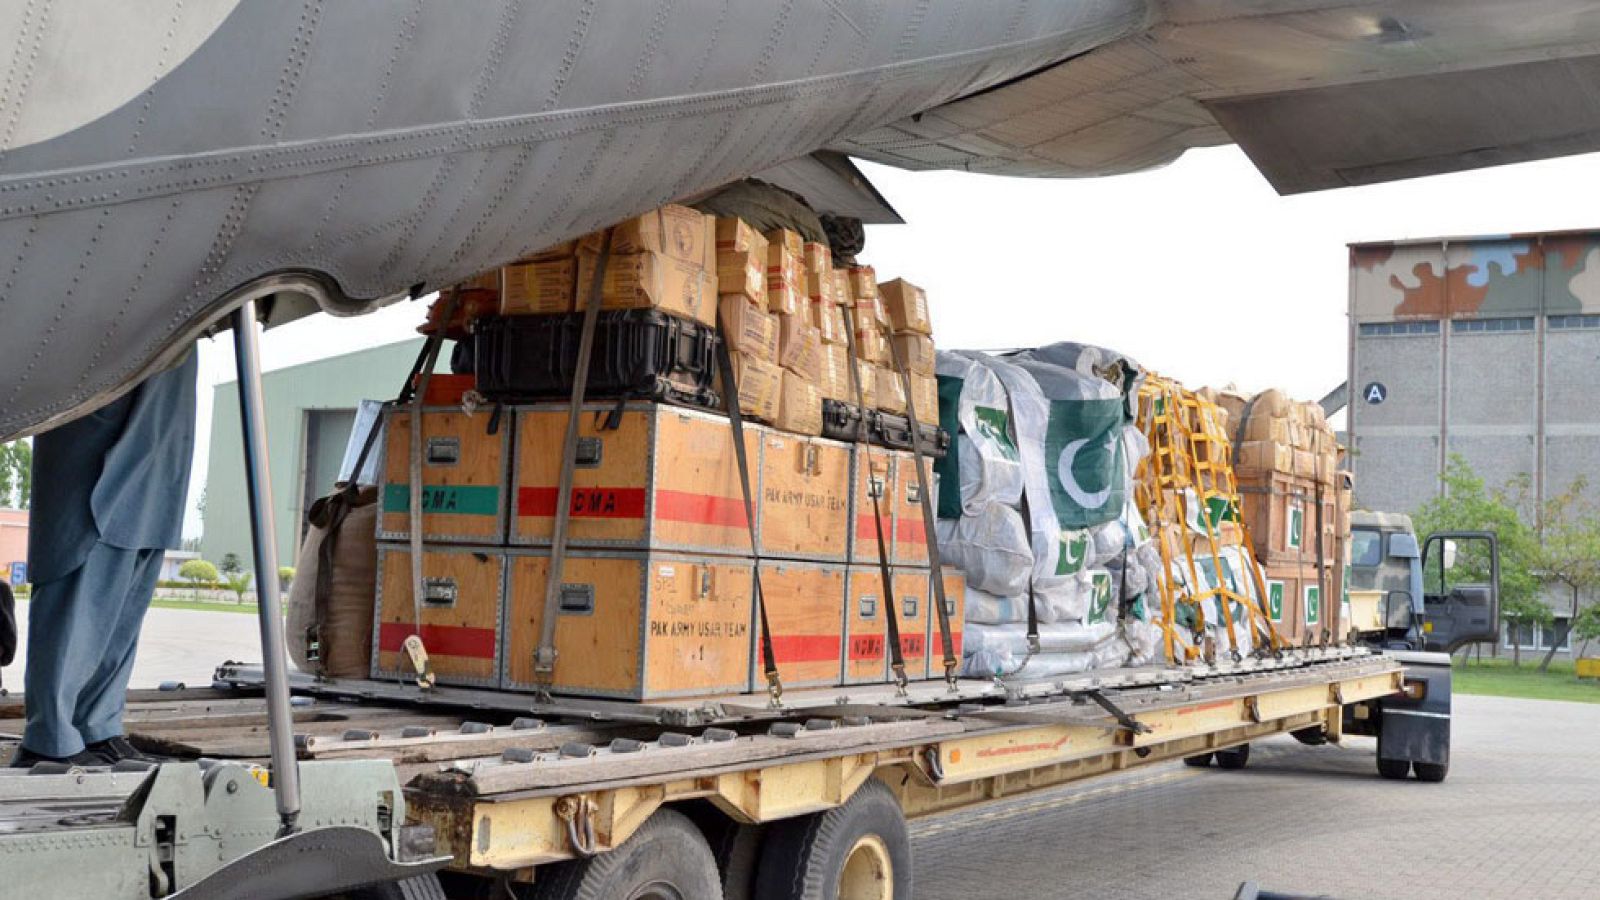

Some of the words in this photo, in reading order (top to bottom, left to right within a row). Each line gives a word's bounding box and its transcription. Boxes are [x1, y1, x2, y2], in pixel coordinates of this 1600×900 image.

[1367, 384, 1383, 401] A
[574, 491, 615, 512] DMA
[765, 487, 780, 503] PAK
[781, 490, 804, 506] ARMY
[827, 496, 846, 511] TEAM
[651, 620, 668, 637] PAK
[671, 621, 695, 637] ARMY
[698, 621, 721, 637] USAR
[724, 622, 747, 638] TEAM
